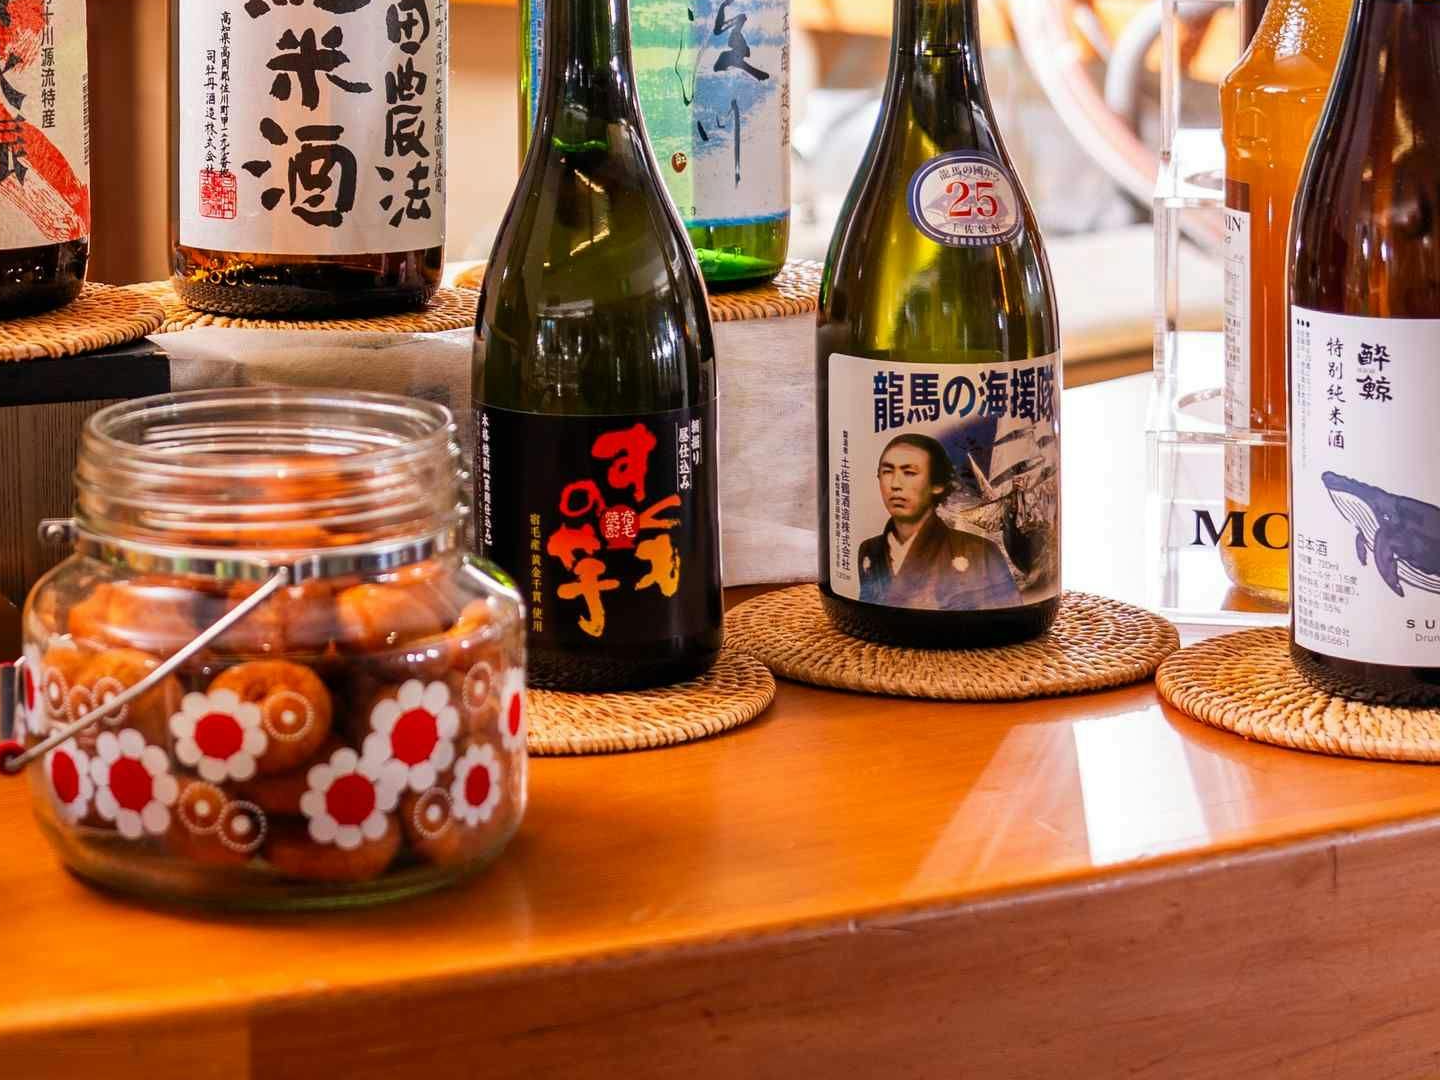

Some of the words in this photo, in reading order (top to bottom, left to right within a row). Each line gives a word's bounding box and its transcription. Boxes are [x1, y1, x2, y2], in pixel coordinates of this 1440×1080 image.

[945, 181, 998, 217] 25
[1326, 337, 1346, 450] 特別純米酒
[1356, 342, 1392, 402] 酔鯨
[873, 367, 1055, 433] 龍馬の海援隊
[1191, 509, 1289, 550] MO
[1298, 533, 1328, 557] 日本酒
